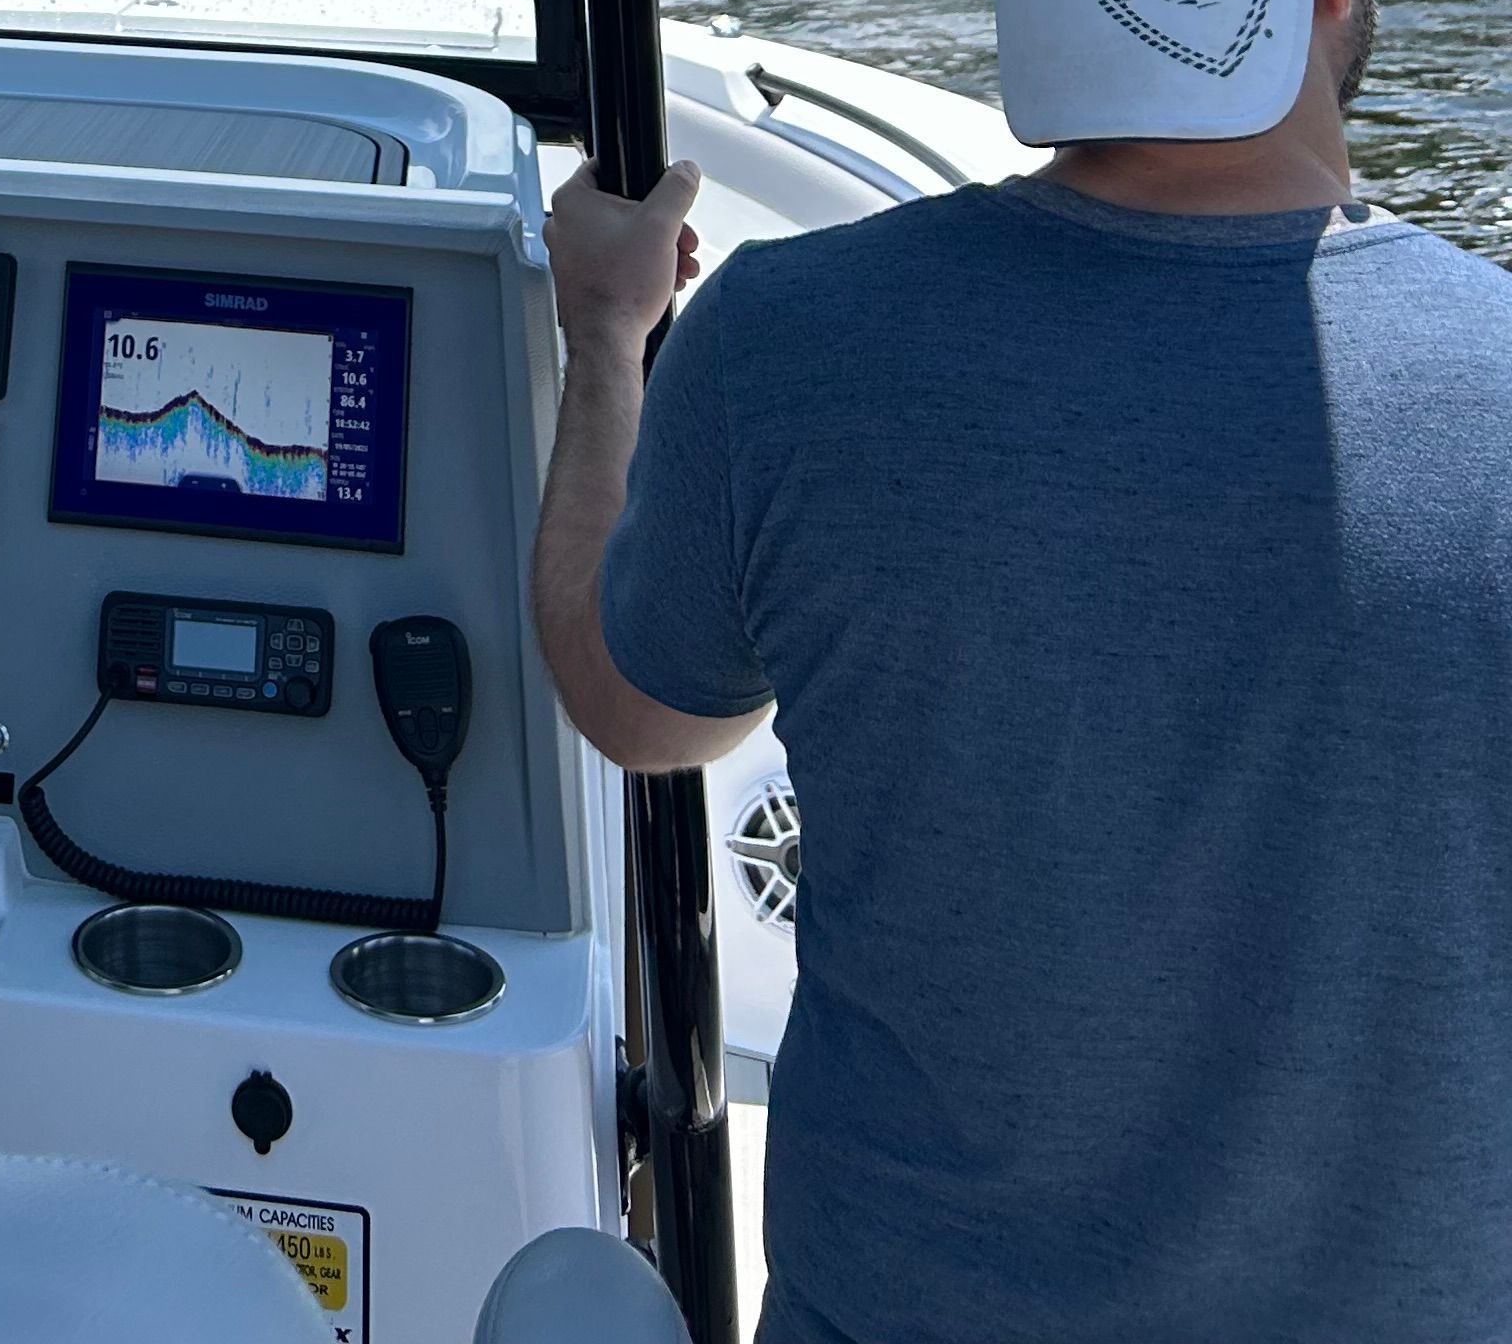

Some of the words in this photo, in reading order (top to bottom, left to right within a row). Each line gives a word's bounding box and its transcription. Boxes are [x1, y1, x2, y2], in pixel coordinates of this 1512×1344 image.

[203, 292, 269, 311] SIMRAD
[107, 333, 160, 361] 10.6
[345, 349, 365, 363] 3.7
[342, 371, 367, 386] 10.6
[340, 394, 366, 409] 86.4
[337, 486, 363, 501] 13.4
[258, 1208, 335, 1232] CAPACITIES
[319, 1266, 341, 1280] GEAR
